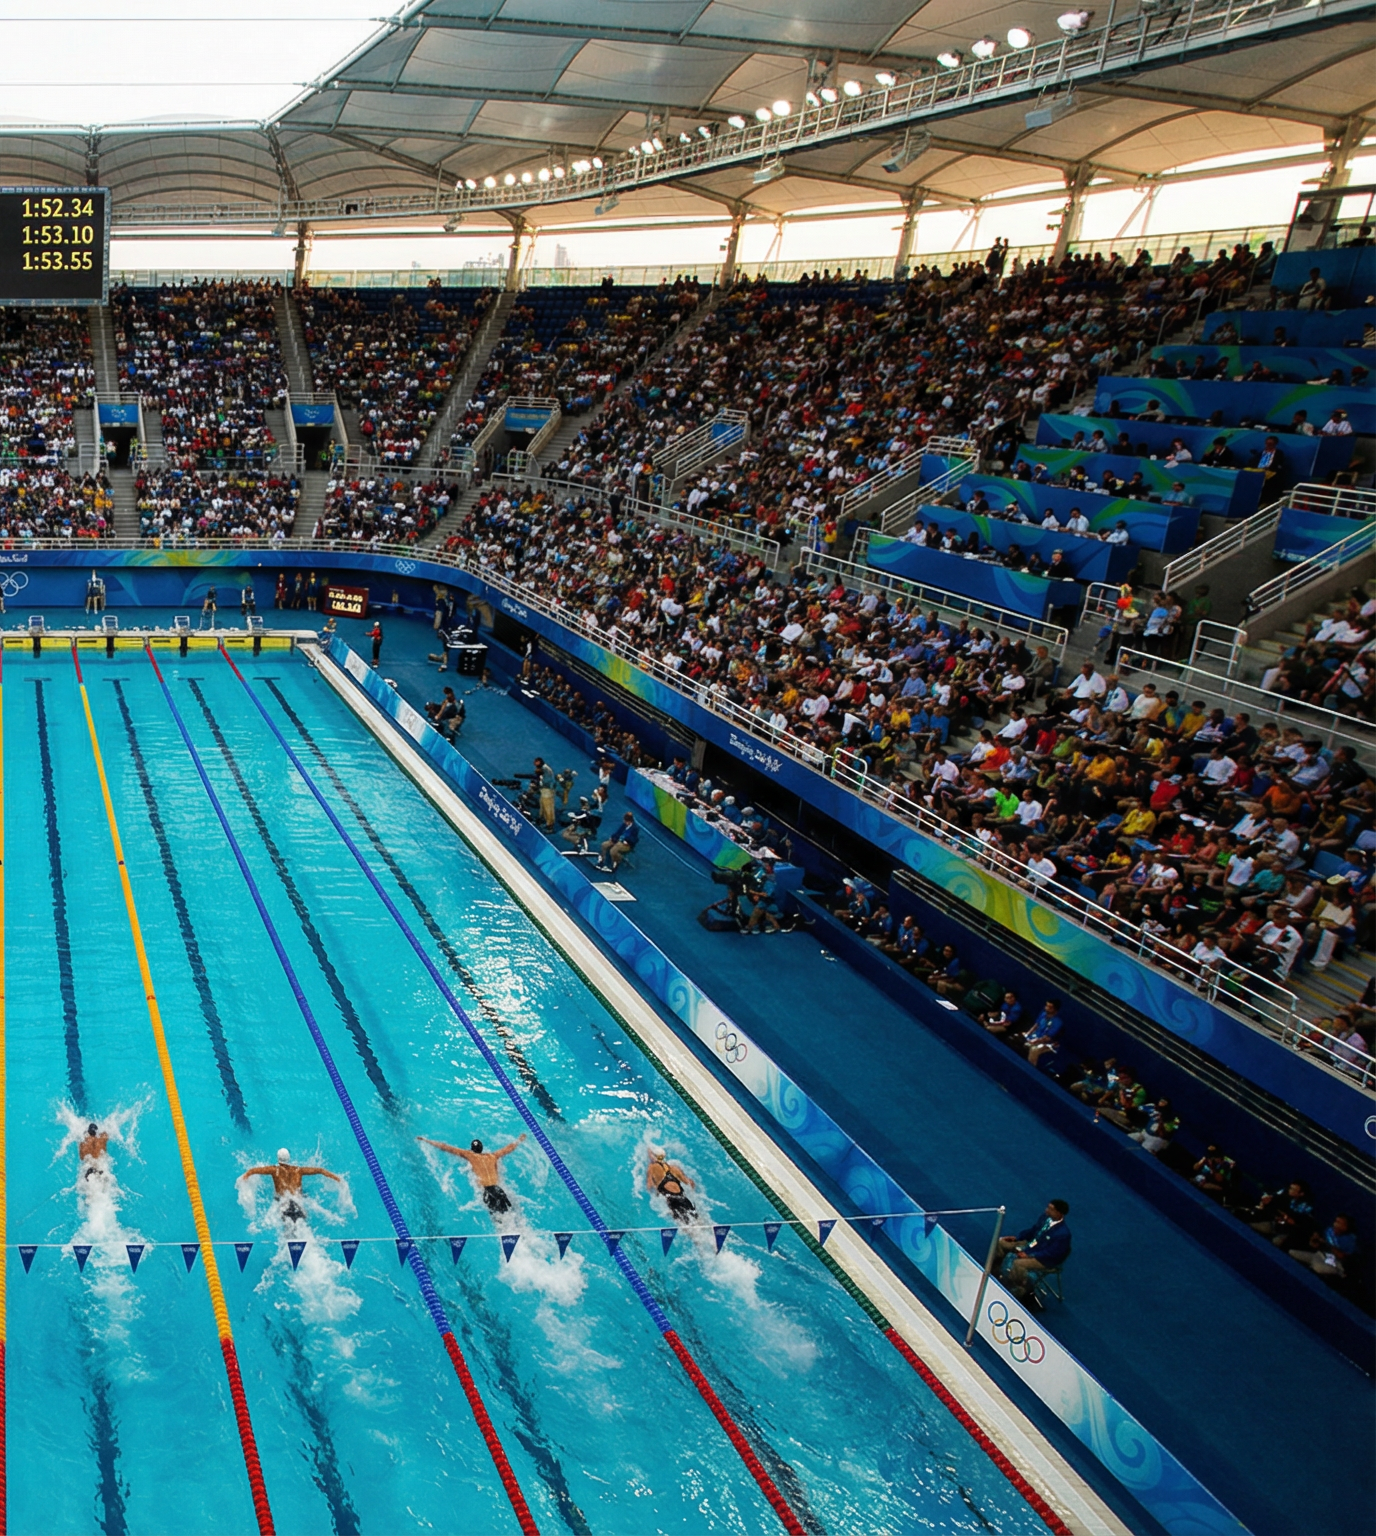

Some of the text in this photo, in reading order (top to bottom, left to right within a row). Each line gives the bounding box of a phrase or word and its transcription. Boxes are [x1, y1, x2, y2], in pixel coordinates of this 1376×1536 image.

[23, 198, 93, 217] 1:52.34
[23, 226, 93, 244] 1:53.10
[23, 252, 92, 270] 1:53.55
